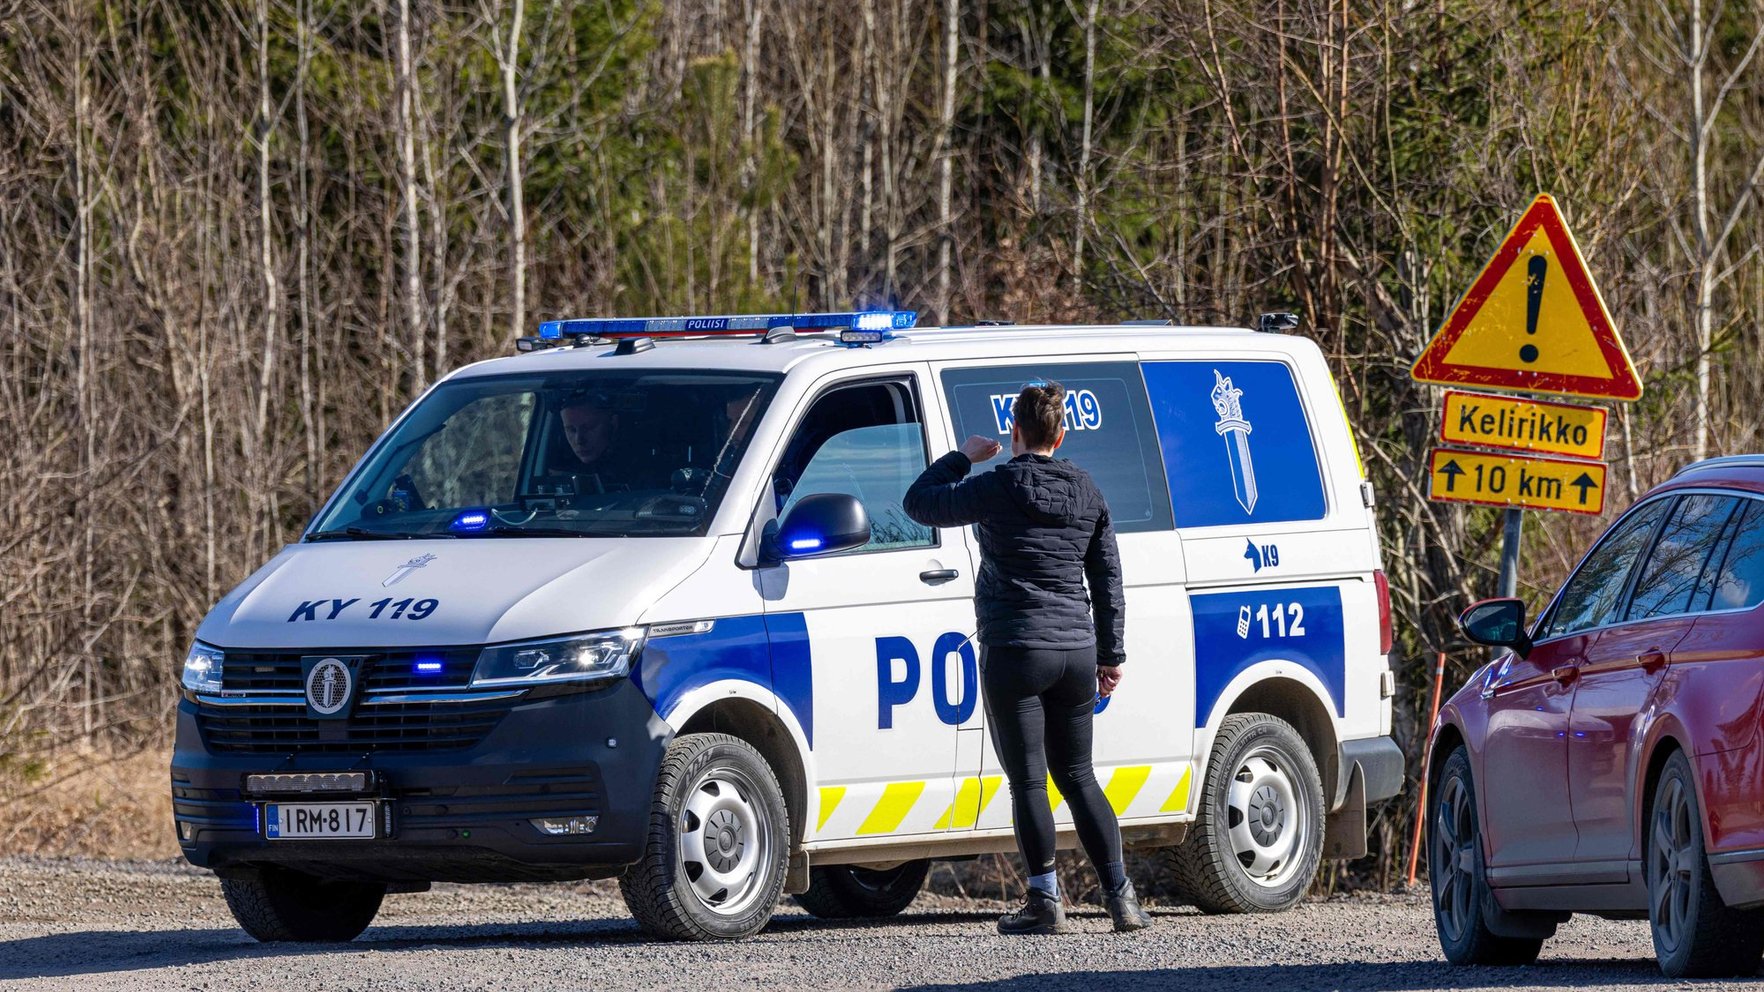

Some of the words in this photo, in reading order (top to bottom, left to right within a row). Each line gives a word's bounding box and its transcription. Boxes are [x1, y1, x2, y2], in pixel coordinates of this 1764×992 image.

[688, 319, 725, 329] POLIISI
[990, 393, 1020, 434] K
[1063, 390, 1102, 430] 19
[1459, 404, 1588, 446] Kelirikko
[1475, 464, 1506, 493] 10
[1519, 469, 1562, 499] km
[1261, 544, 1279, 567] K9
[287, 598, 361, 622] KY
[368, 597, 440, 620] 119
[1256, 602, 1305, 638] 112
[268, 824, 279, 832] FIN
[286, 808, 367, 833] IRM-817
